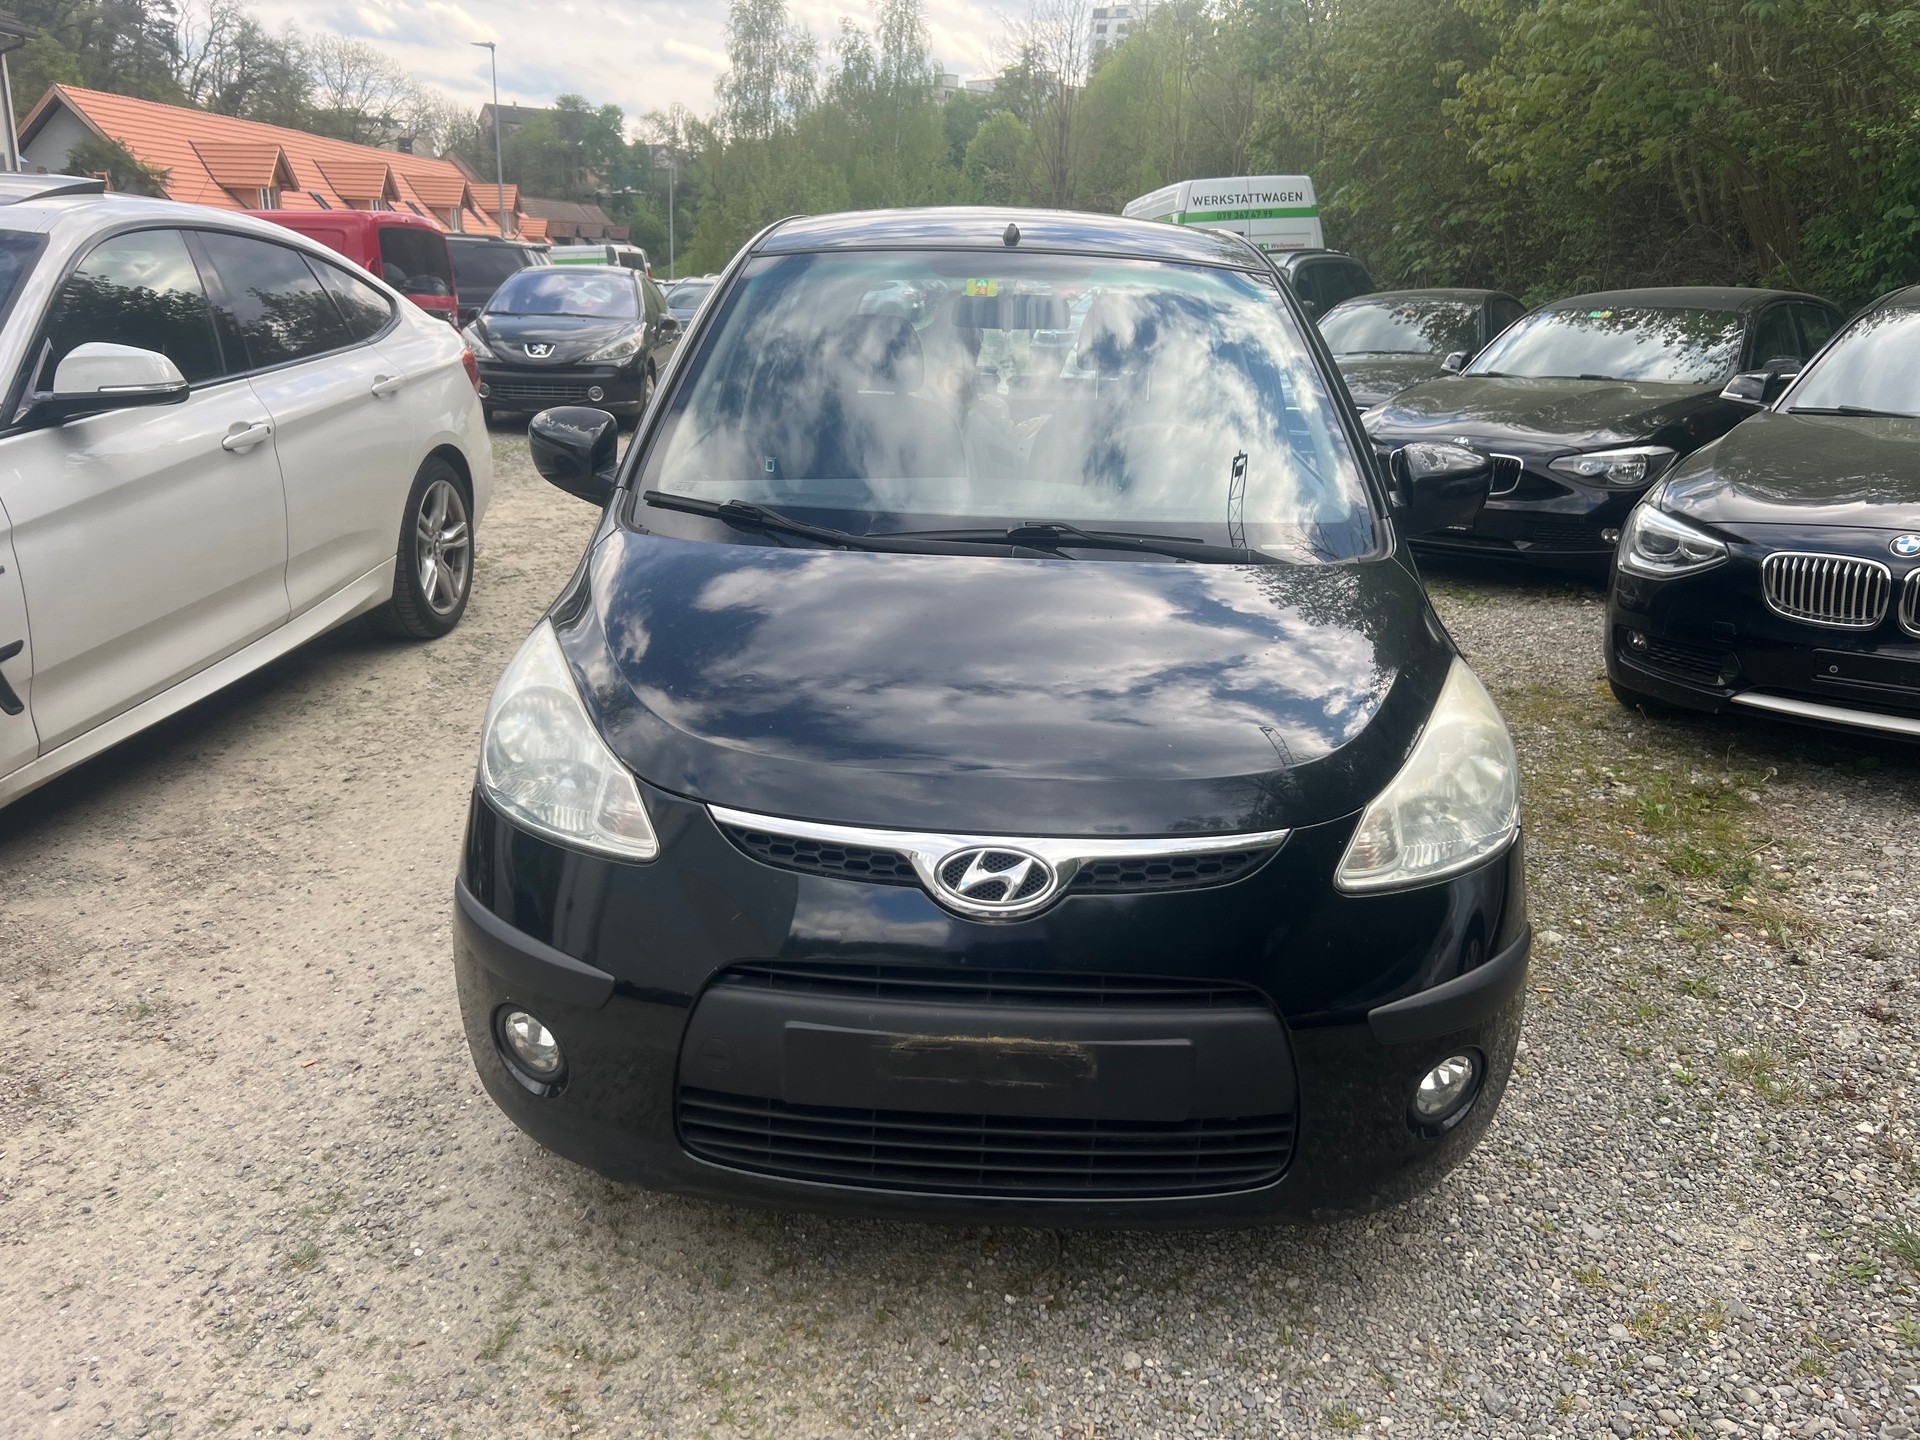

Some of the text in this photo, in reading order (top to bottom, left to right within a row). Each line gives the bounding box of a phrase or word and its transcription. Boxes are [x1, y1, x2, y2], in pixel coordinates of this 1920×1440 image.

[1192, 191, 1303, 206] WERKSTATTWAGEN
[1216, 209, 1273, 220] 079 367 47 99
